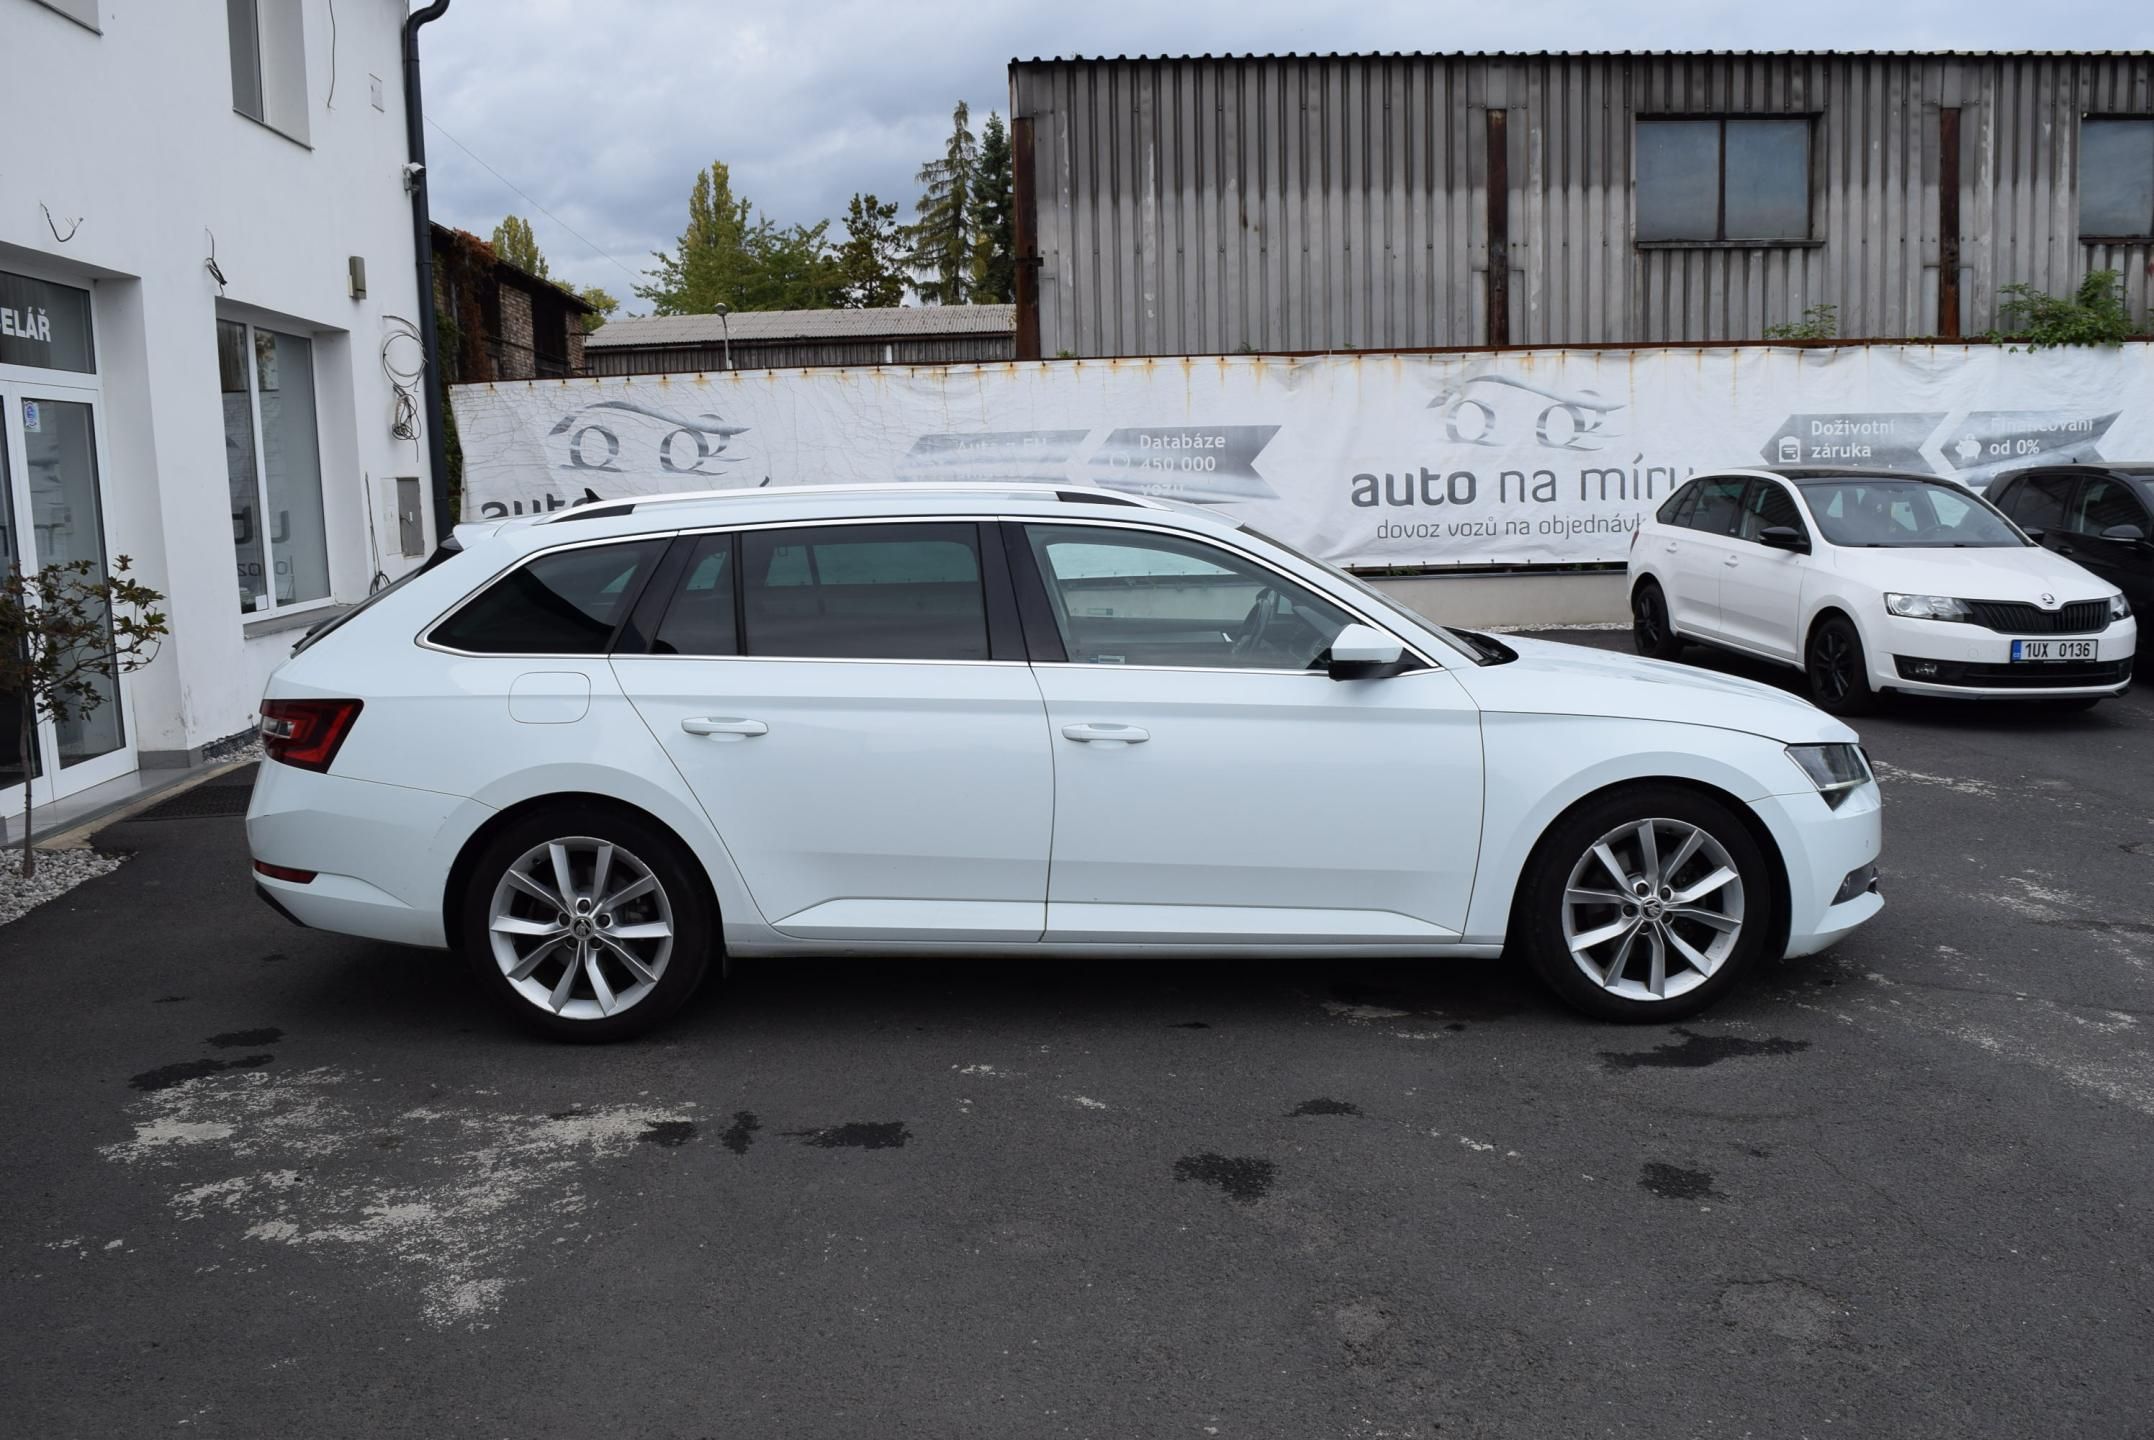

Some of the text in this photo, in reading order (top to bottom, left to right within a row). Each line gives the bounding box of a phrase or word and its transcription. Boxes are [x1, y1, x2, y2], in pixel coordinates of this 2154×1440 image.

[0, 306, 52, 343] ELÁŘ
[1811, 419, 1896, 436] Doživotní
[1140, 433, 1227, 449] Databáze
[1989, 439, 2040, 455] od 0%
[1811, 442, 1872, 458] záruka
[1181, 456, 1216, 472] 000
[1351, 466, 1477, 508] auto
[1500, 469, 1557, 503] na
[1377, 519, 1441, 539] dovoz
[1448, 515, 1497, 537] vozů
[1505, 520, 1530, 536] na
[2025, 642, 2091, 658] 1UX 0136
